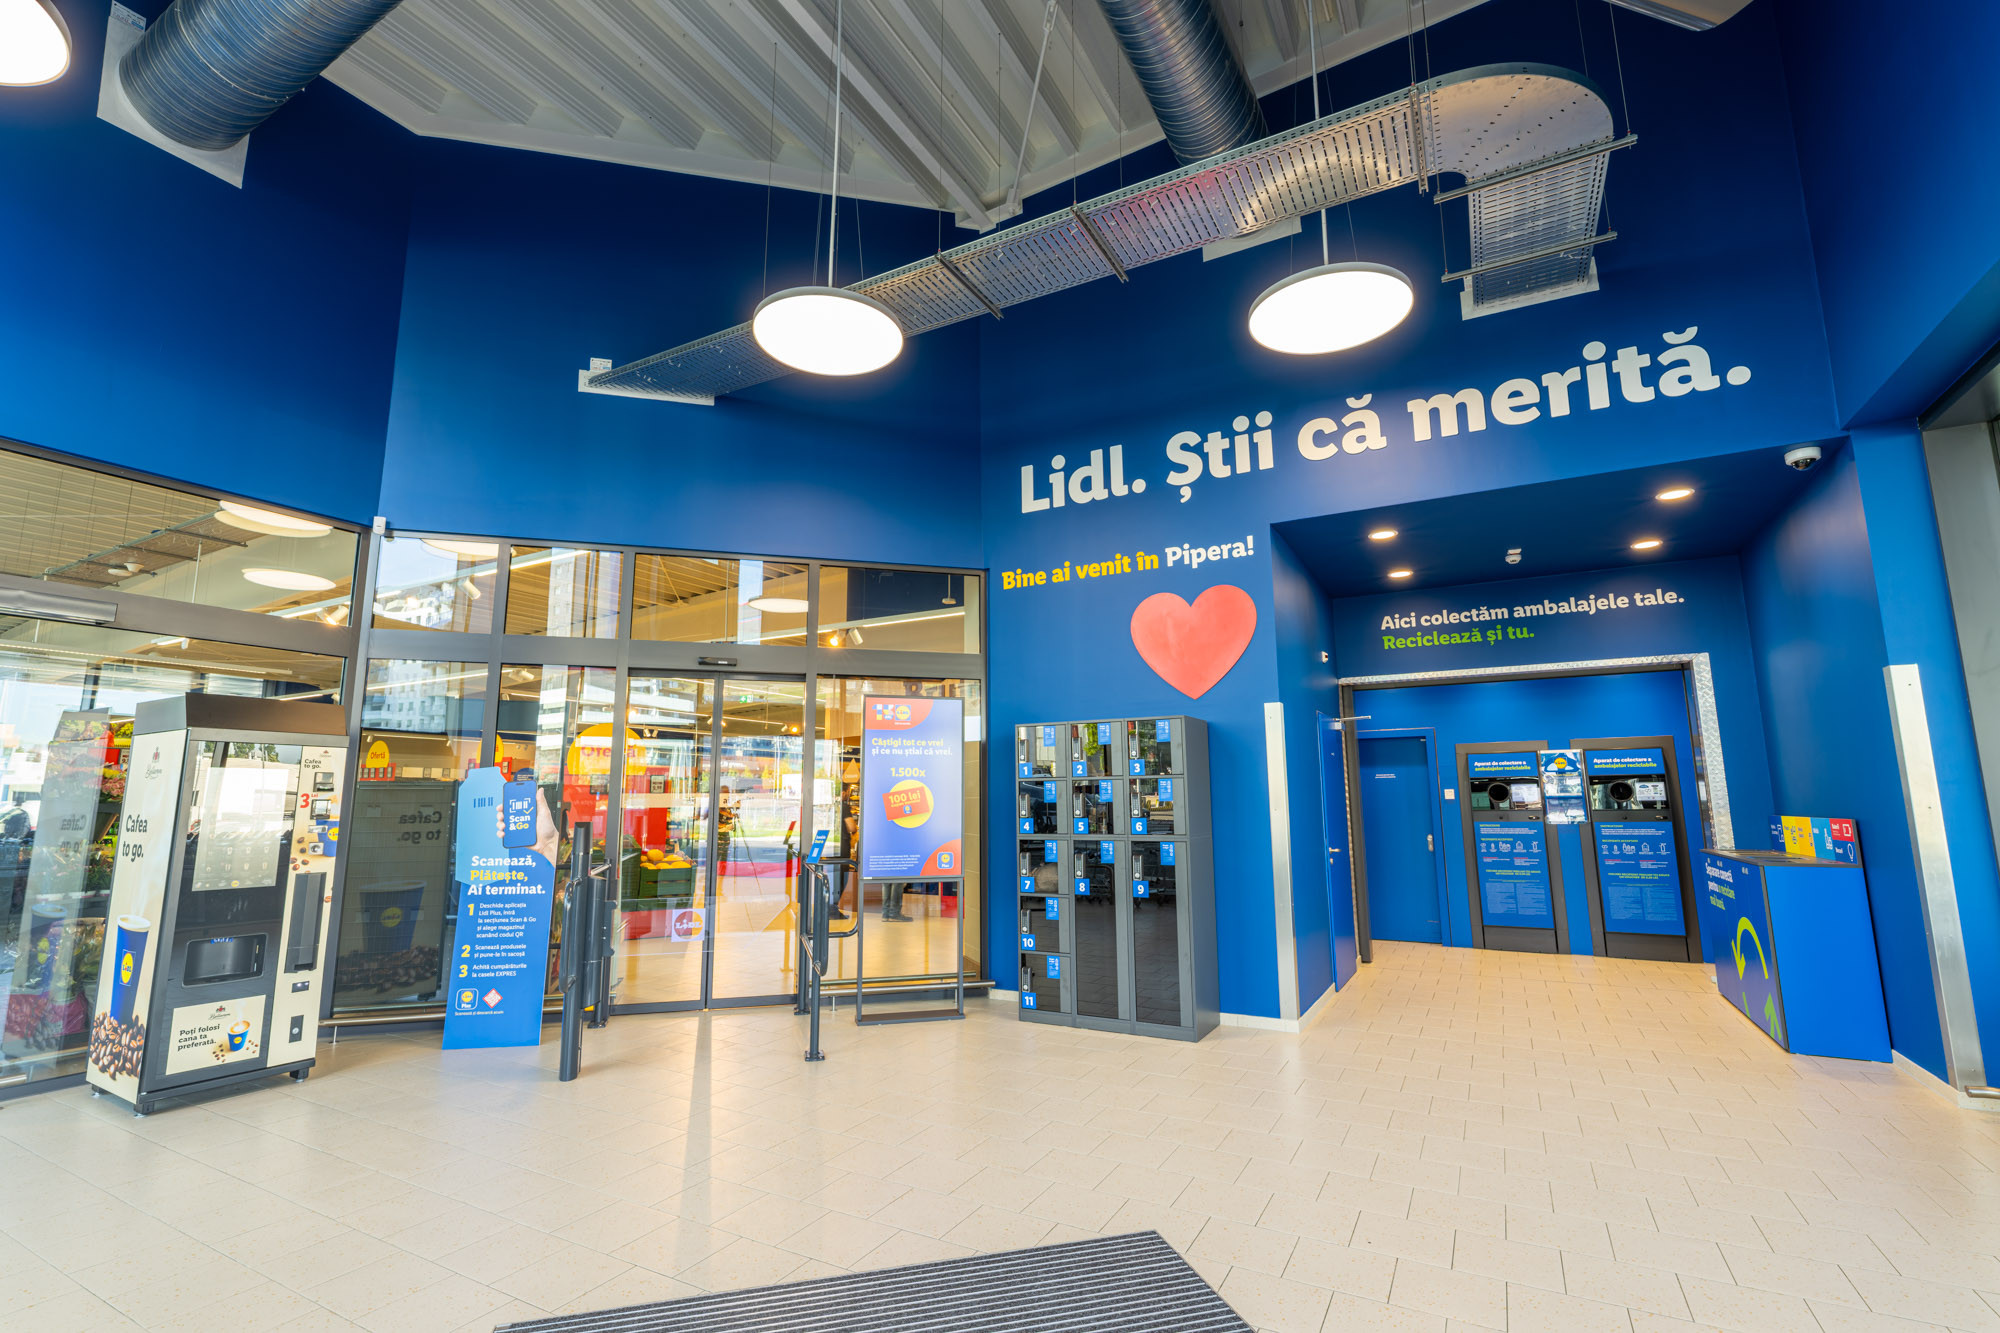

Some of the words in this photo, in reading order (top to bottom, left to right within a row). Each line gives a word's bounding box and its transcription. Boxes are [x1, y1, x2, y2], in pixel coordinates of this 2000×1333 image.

[1021, 444, 1146, 514] Lidl.
[1165, 410, 1274, 503] Știi
[1297, 393, 1388, 461] că
[1407, 326, 1752, 442] merită.
[1001, 568, 1047, 590] Bine
[1051, 561, 1071, 583] ai
[1075, 553, 1131, 579] venit
[1136, 551, 1159, 571] în
[1165, 535, 1254, 569] Pipera!
[1381, 612, 1417, 630] Aici
[1420, 605, 1509, 627] colectăm
[1513, 593, 1629, 618] ambalajele
[1633, 588, 1685, 607] tale.
[1382, 628, 1482, 650] Reciclează
[1486, 625, 1503, 646] și
[1507, 626, 1535, 640] tu.
[928, 738, 944, 747] vrei
[891, 767, 926, 777] 1.500x
[1023, 766, 1028, 775] 1
[1076, 765, 1083, 774] 2
[1134, 763, 1141, 773] 3
[300, 793, 310, 809] 3
[888, 793, 907, 804] 100
[909, 790, 921, 800] lei
[125, 814, 148, 833] Cafea
[509, 815, 531, 823] Scan
[1023, 822, 1030, 831] 4
[1078, 822, 1084, 832] 5
[1135, 822, 1143, 832] 6
[122, 840, 130, 857] to
[131, 843, 144, 863] go.
[471, 855, 537, 868] Scanează,
[470, 870, 528, 883] Plătește,
[467, 884, 483, 896] Ai
[485, 883, 546, 895] terminat.
[1024, 880, 1031, 890] 7
[1079, 882, 1086, 892] 8
[1137, 885, 1144, 895] 9
[467, 903, 475, 916] 1
[675, 918, 702, 930] LIDL
[1022, 938, 1034, 948] 10
[461, 944, 471, 958] 2
[459, 964, 468, 978] 3
[1023, 996, 1034, 1006] 11
[198, 1023, 220, 1033] folosi
[178, 1035, 198, 1043] cana
[177, 1039, 217, 1052] preferată.
